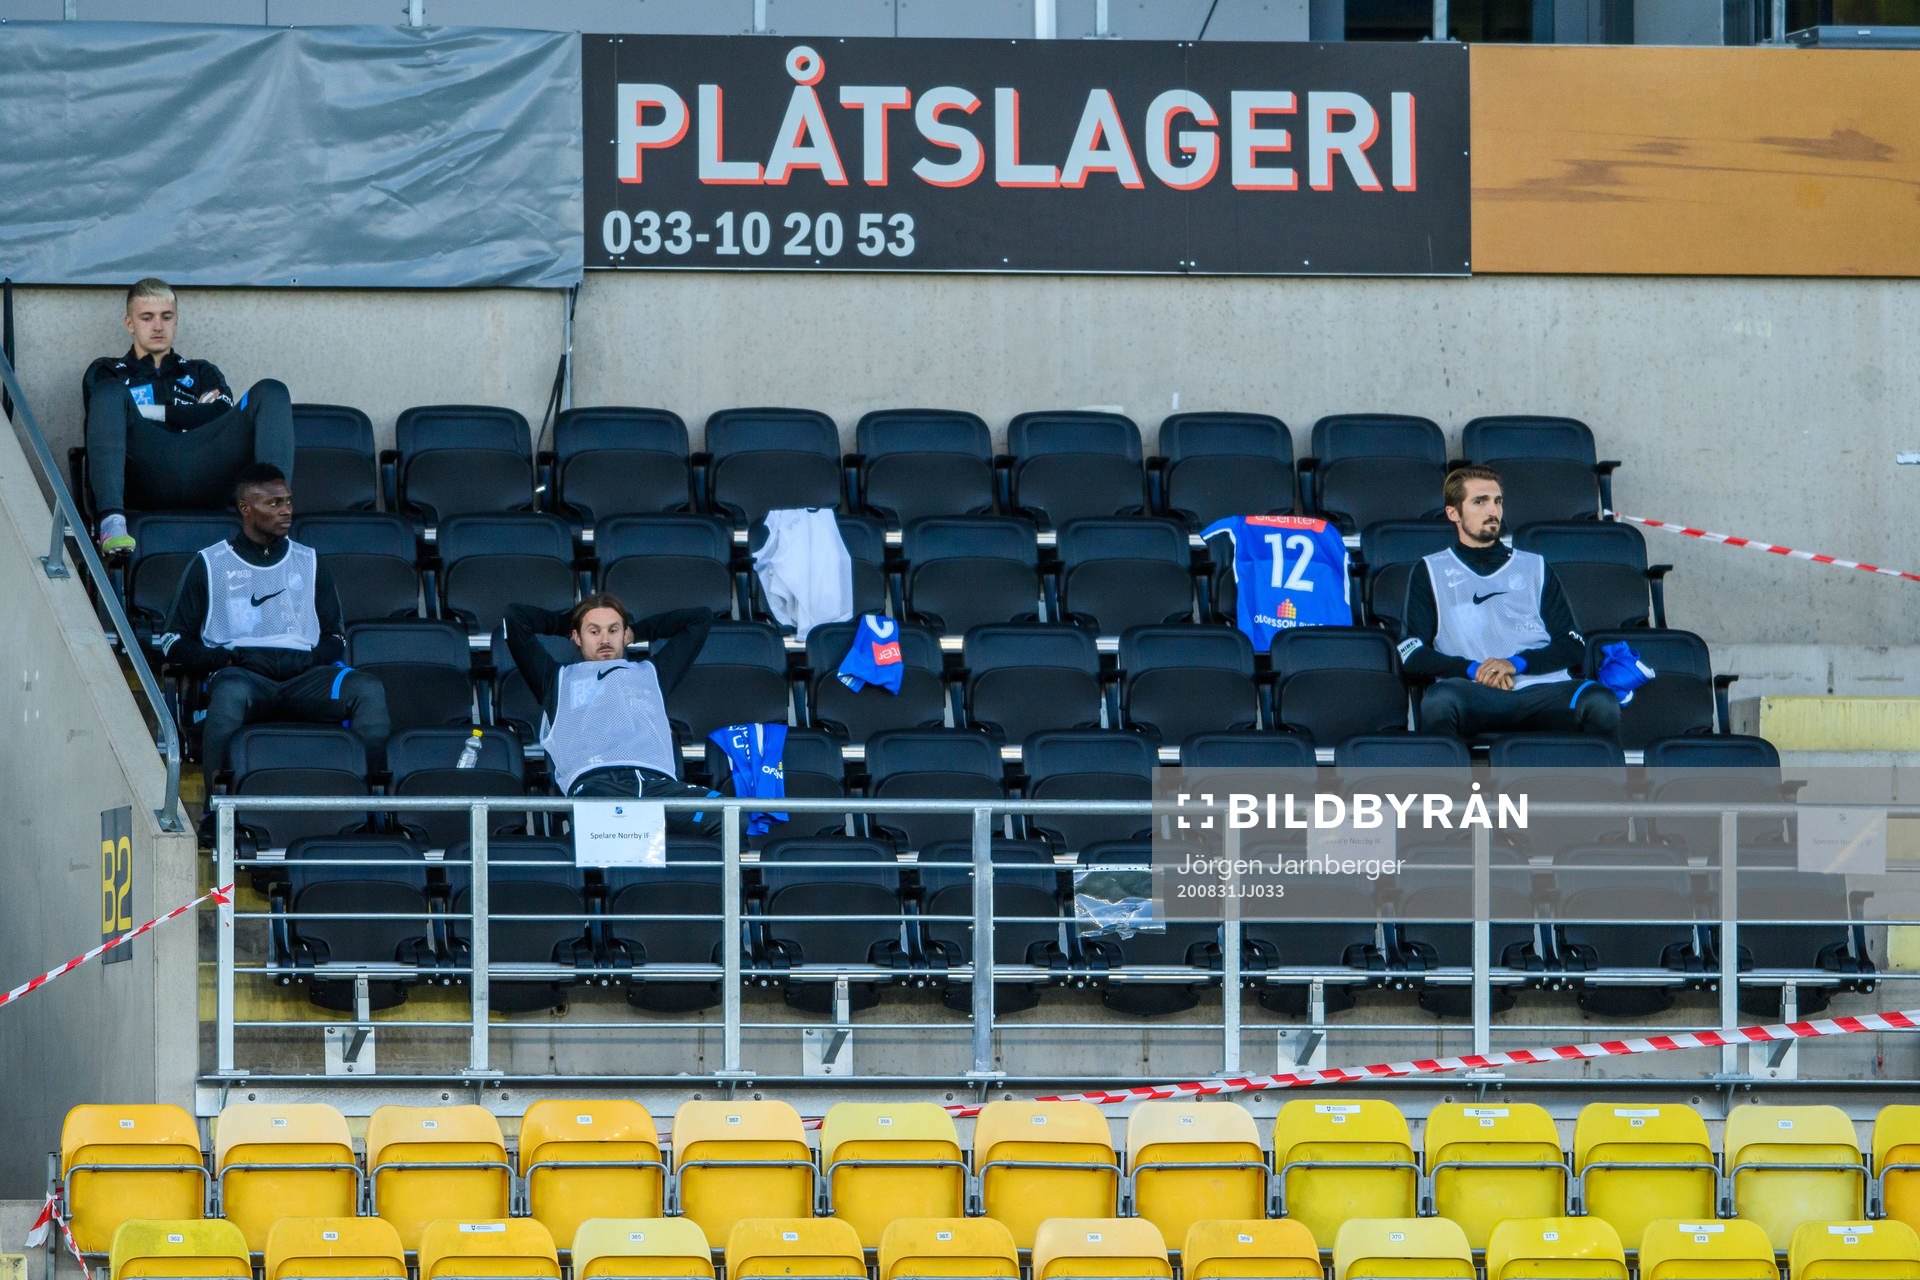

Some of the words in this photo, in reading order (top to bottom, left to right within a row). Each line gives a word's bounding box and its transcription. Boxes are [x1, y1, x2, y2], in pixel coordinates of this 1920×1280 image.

[616, 45, 1417, 192] PLÅTSLAGERI
[602, 210, 771, 255] 033-10
[783, 211, 844, 257] 20
[856, 212, 916, 257] 53
[1264, 533, 1315, 593] 12
[590, 832, 617, 840] Spelare
[618, 832, 642, 841] Norrby
[101, 836, 132, 934] B2
